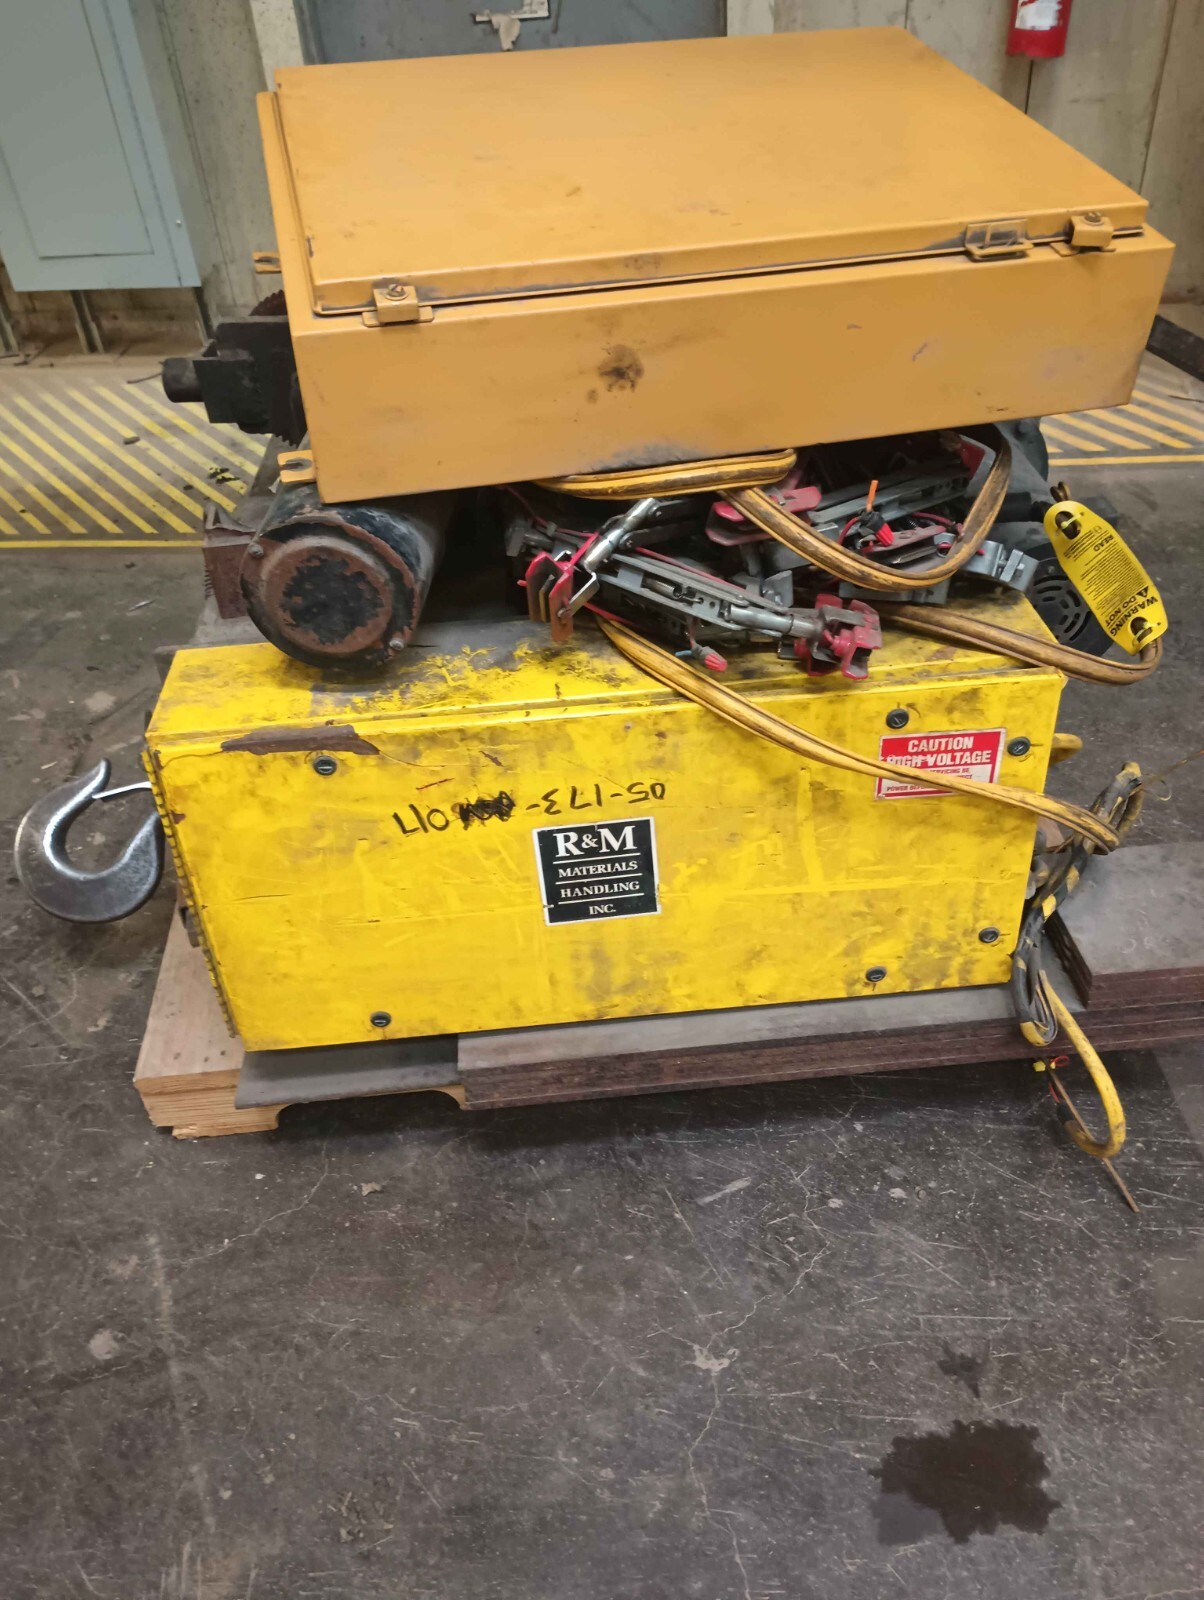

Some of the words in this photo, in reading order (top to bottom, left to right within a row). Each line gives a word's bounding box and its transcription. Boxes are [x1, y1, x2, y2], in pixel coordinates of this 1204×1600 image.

[1122, 595, 1137, 609] DO
[1105, 608, 1121, 626] NOT
[1110, 596, 1158, 636] WARNING
[908, 737, 974, 752] CAUTION
[925, 750, 992, 766] VOLTAGE
[552, 825, 638, 858] R&M
[558, 861, 638, 878] MATERIALS
[560, 881, 640, 898] HANDLING
[589, 904, 616, 915] INC.
